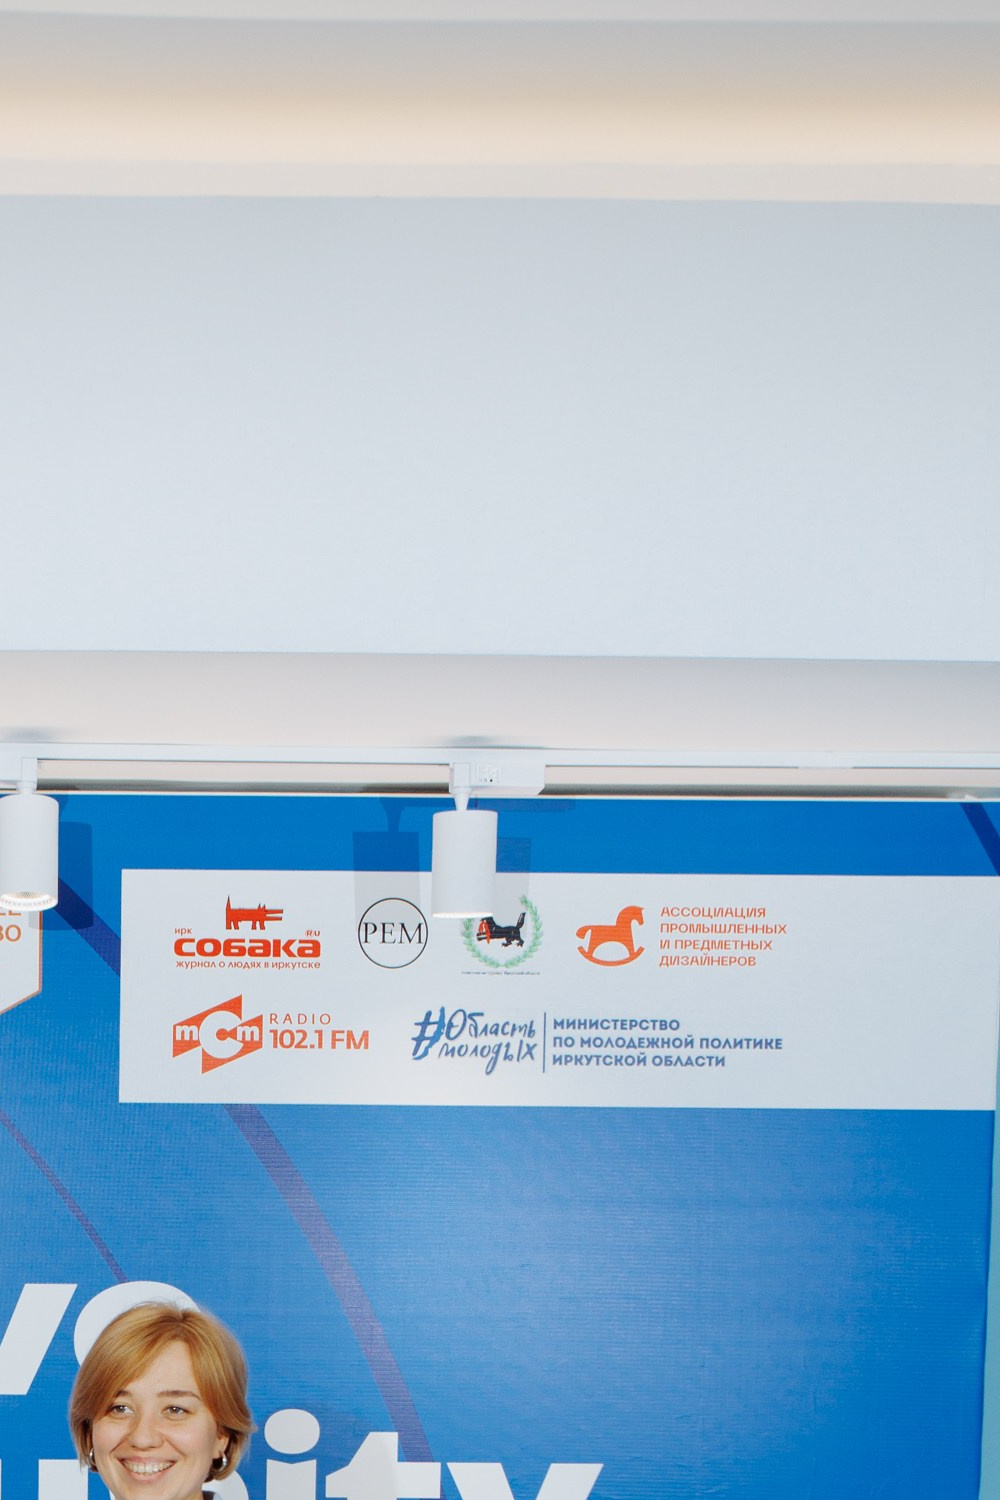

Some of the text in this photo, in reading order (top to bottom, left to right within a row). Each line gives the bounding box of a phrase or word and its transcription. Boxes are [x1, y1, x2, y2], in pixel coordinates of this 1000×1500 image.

[660, 907, 766, 920] АССОЦИАЦИЯ
[660, 923, 788, 935] ПРОМЫШЛЕННЫХ
[659, 939, 773, 952] И ПРЕДМЕТНЫХ
[176, 960, 216, 970] журнал
[228, 961, 262, 970] людях
[271, 961, 321, 970] иркутске
[658, 952, 757, 968] ДИЗАЙНЕРОВ
[269, 1012, 332, 1025] RADIO
[552, 1018, 681, 1032] МИНИСТЕРСТВО
[269, 1029, 370, 1050] 102.1 FM
[552, 1034, 783, 1050] ПО МОЛОДЕЖНОЙ ПОЛИТИКЕ
[438, 1040, 538, 1075] молодых
[552, 1052, 726, 1068] ИРКУТСКОЙ ОБЛАСТИ
